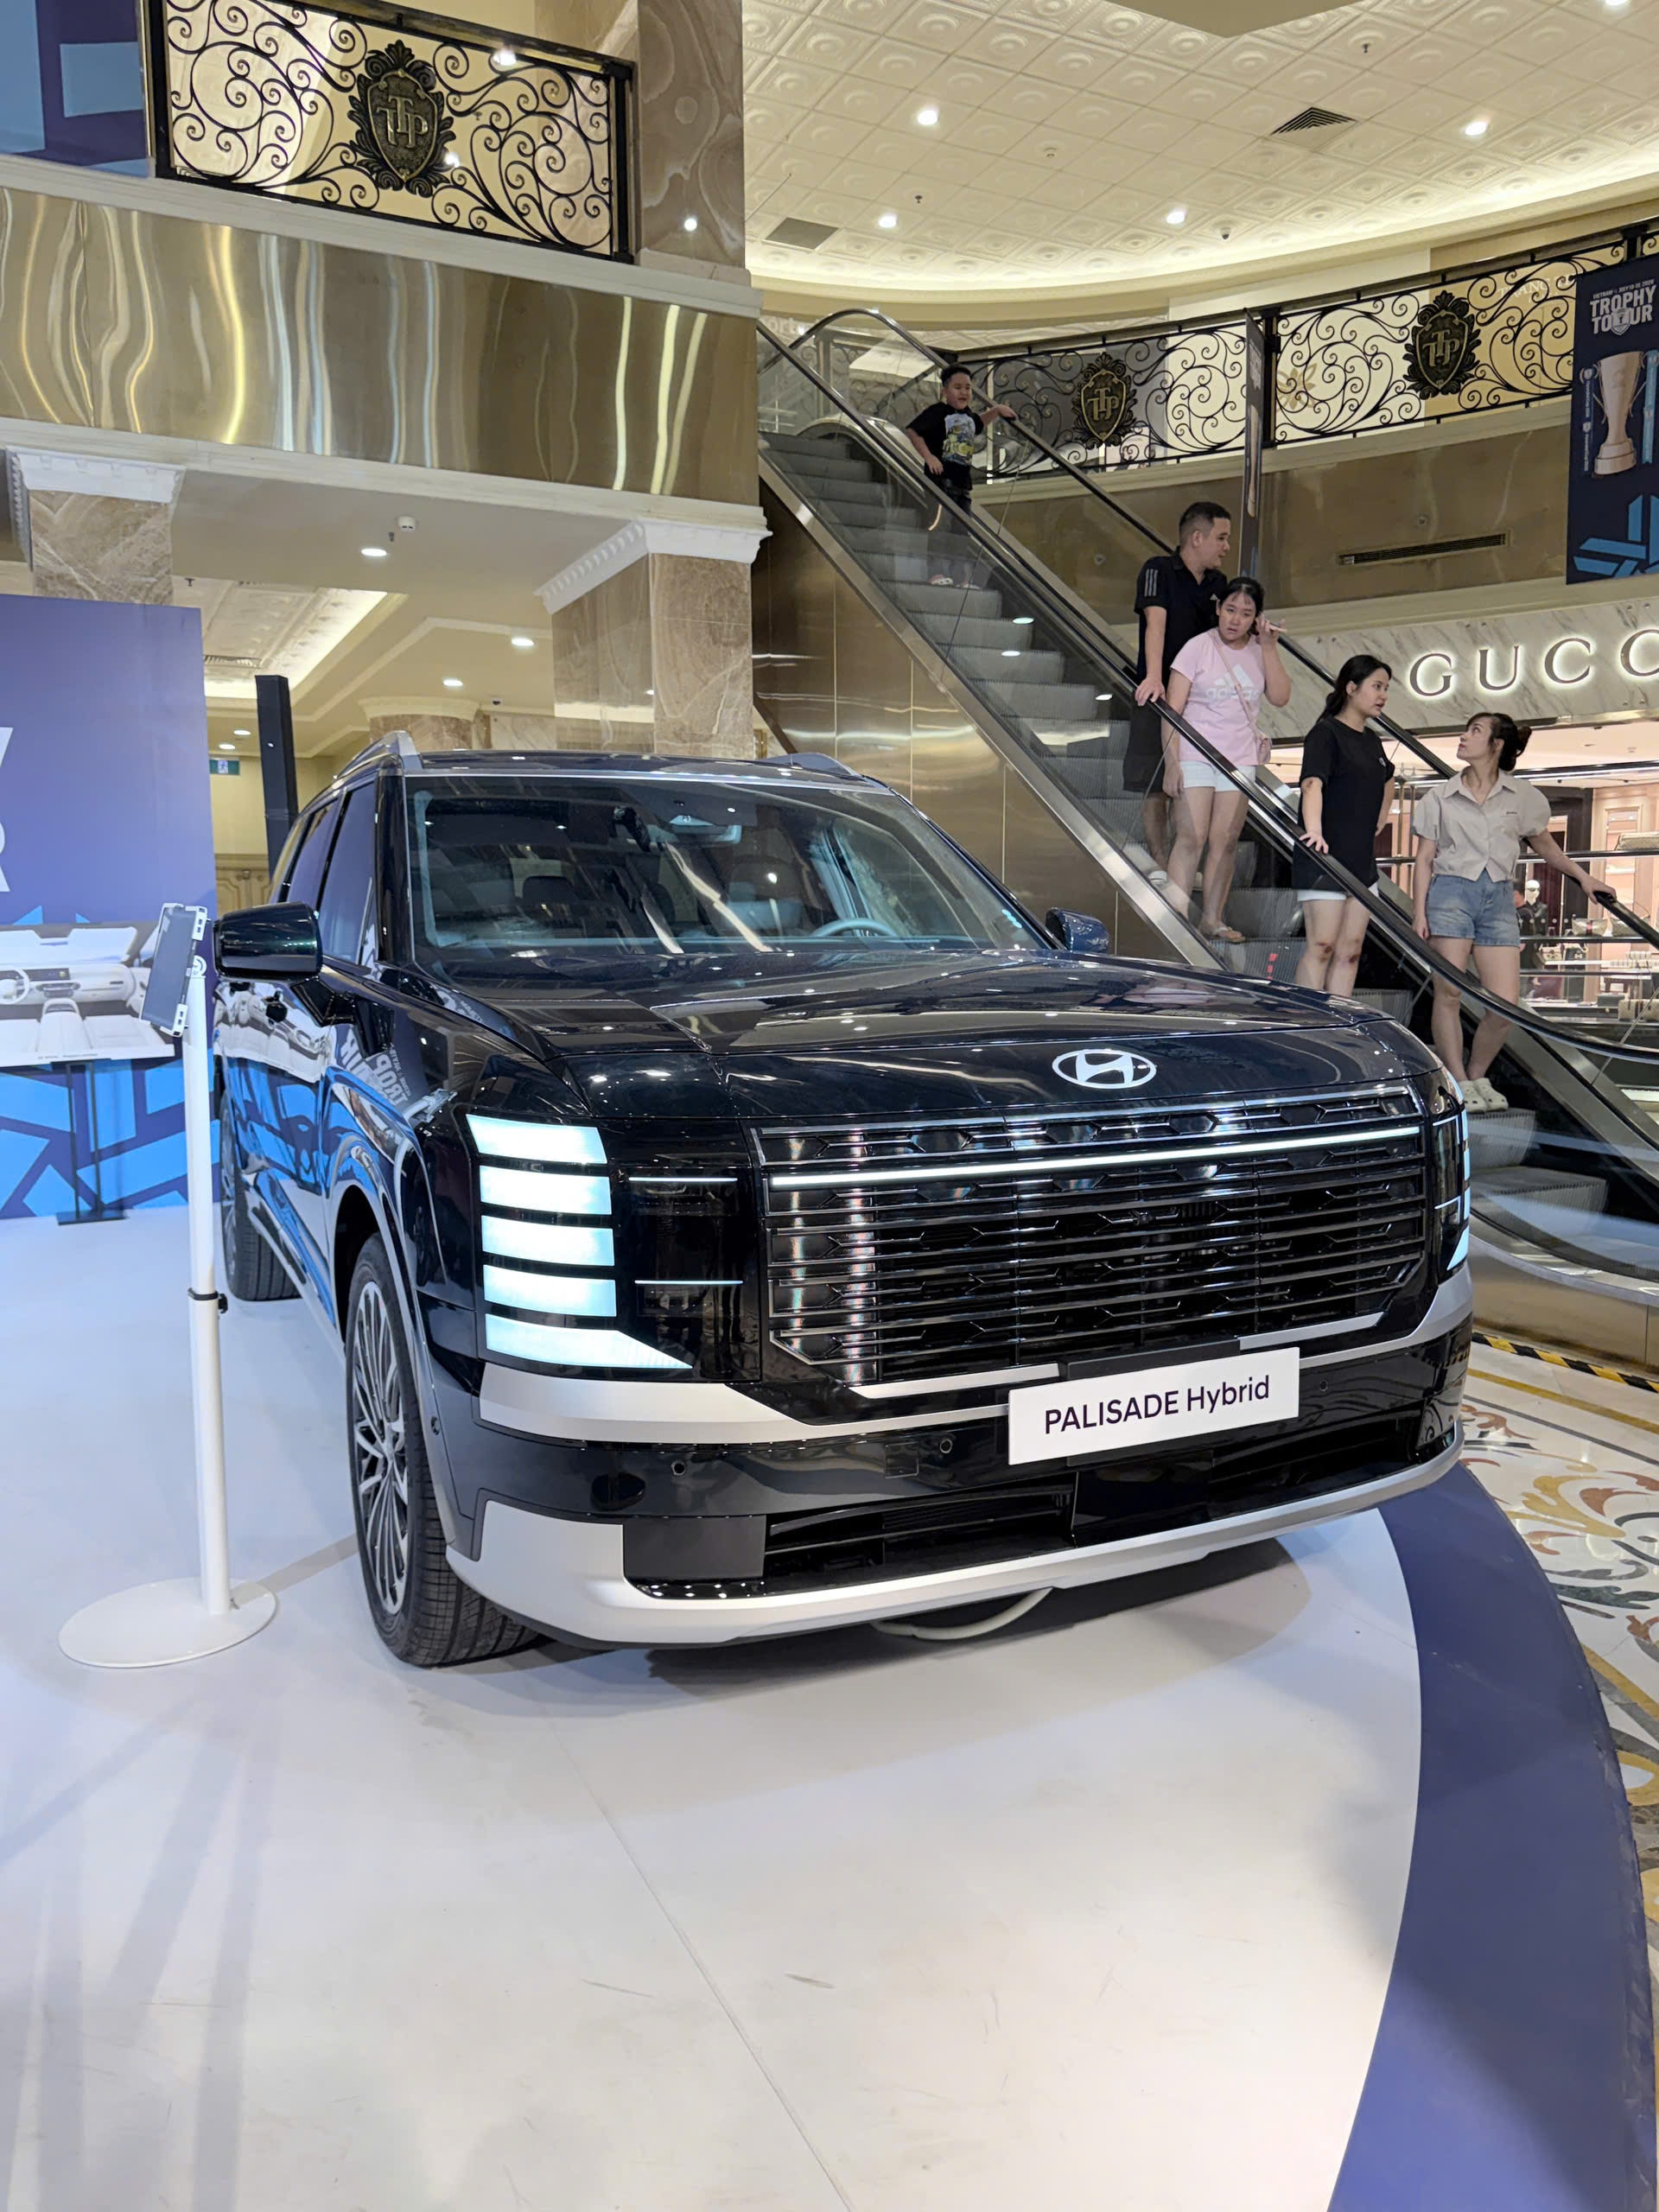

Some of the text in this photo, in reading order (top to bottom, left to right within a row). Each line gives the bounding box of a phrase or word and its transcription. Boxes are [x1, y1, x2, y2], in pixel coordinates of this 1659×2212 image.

[1589, 283, 1657, 318] TROPHY
[1591, 303, 1654, 334] TOUR
[1045, 1374, 1270, 1434] PALISADE Hybrid
